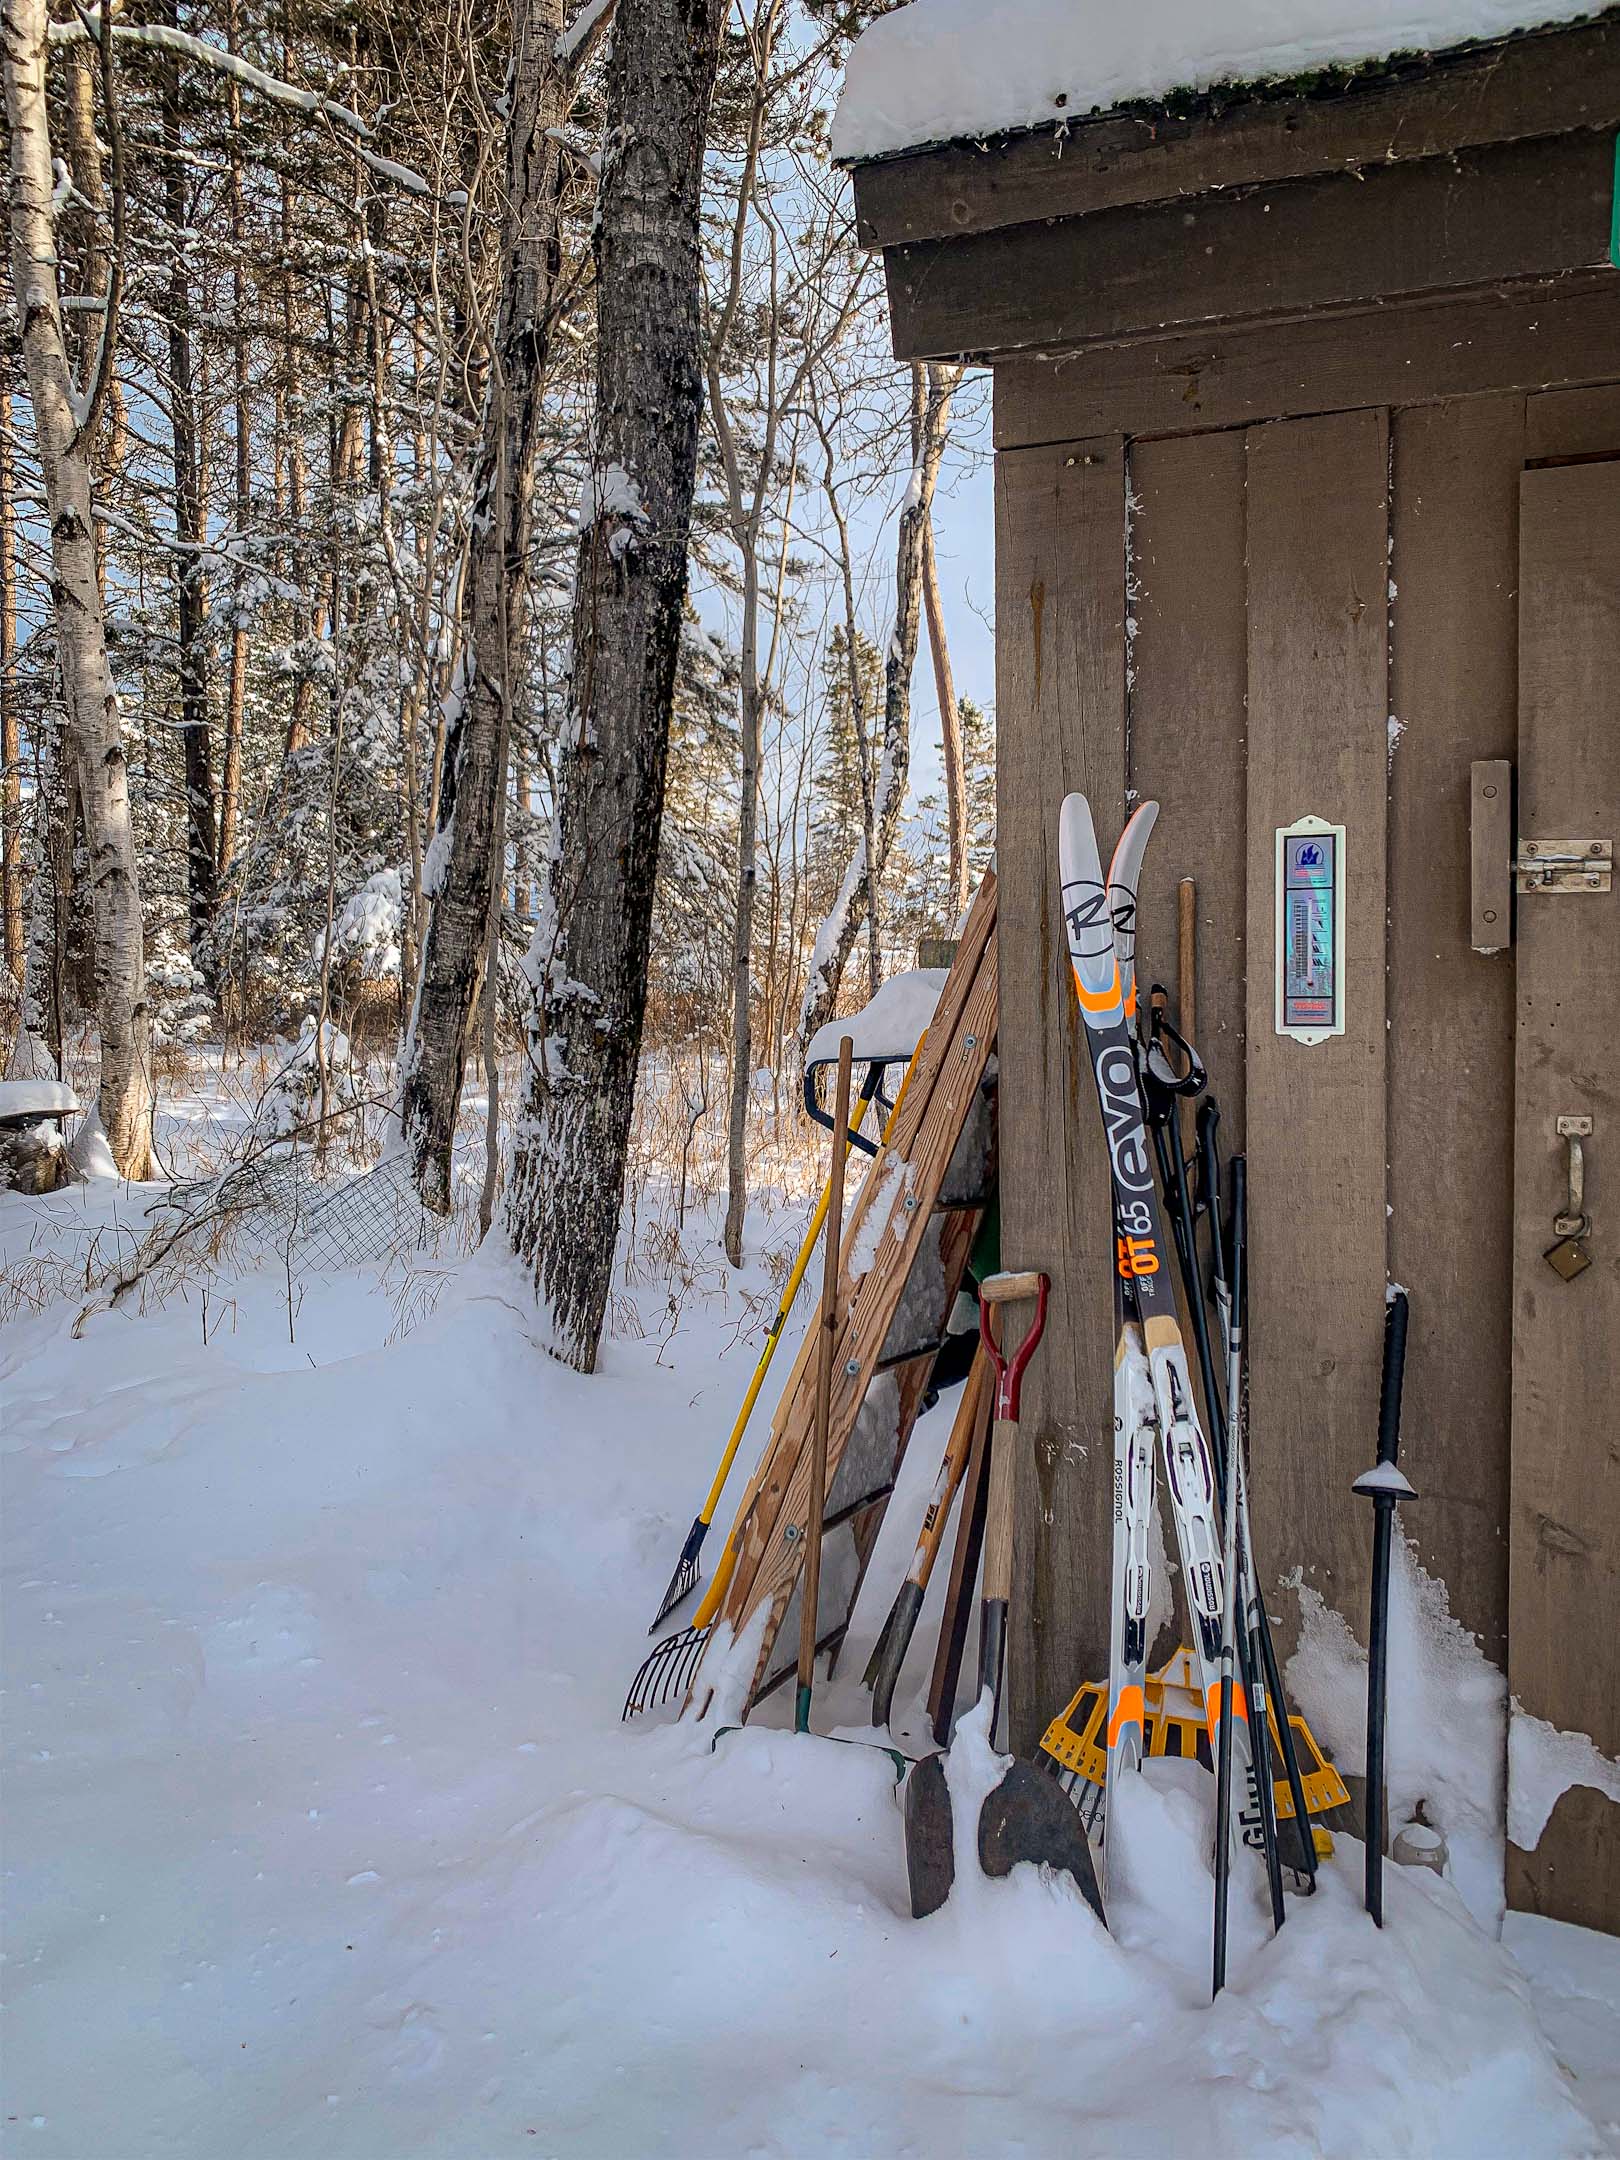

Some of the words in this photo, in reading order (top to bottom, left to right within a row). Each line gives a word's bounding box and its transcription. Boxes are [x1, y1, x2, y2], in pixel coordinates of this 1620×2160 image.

[1096, 1045, 1154, 1191] evo
[1120, 1201, 1152, 1235] 65
[1126, 1235, 1160, 1275] OT
[1138, 1275, 1149, 1292] OFF
[1115, 1459, 1123, 1524] ROSSIGNOL
[1203, 1572, 1216, 1610] ROSSIGNOL
